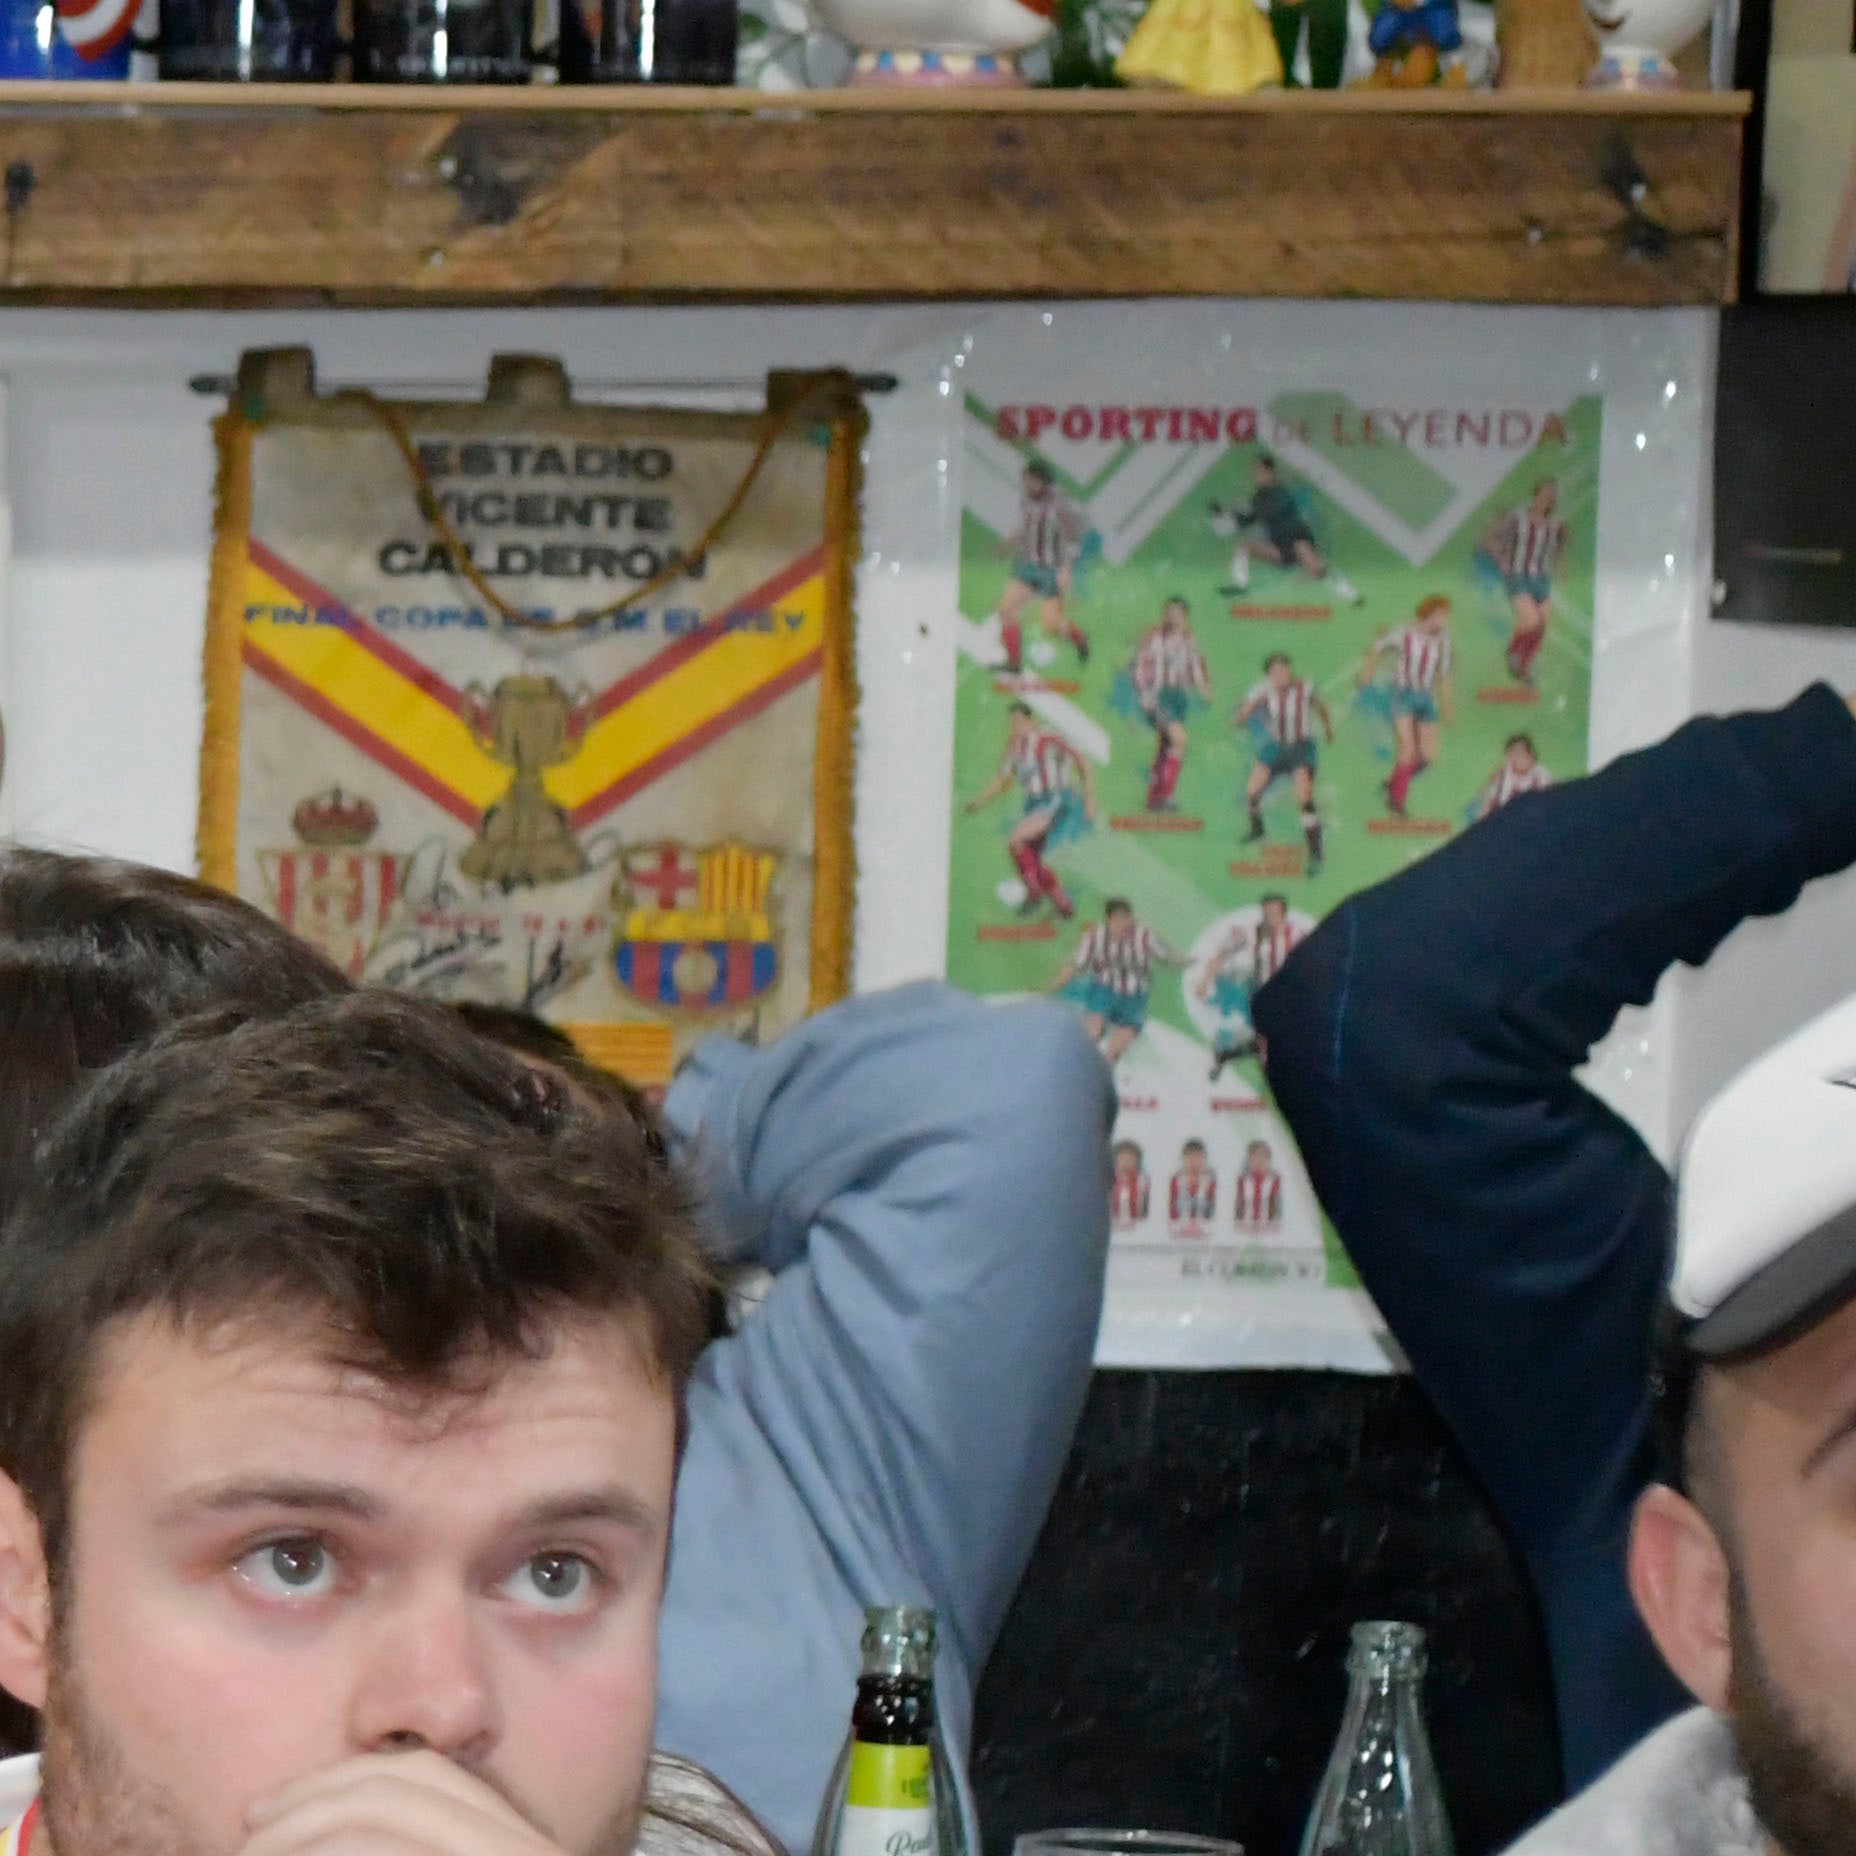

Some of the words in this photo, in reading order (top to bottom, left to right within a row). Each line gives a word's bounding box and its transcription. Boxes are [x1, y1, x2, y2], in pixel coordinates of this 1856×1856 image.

[994, 405, 1257, 442] SPORTING
[1333, 406, 1571, 449] LEYENDA
[417, 442, 674, 481] ESTADIO
[420, 492, 675, 532] VICENTE
[245, 604, 352, 632] FINAL
[378, 606, 488, 632] COPA
[664, 607, 705, 632] EL
[721, 608, 806, 634] REY
